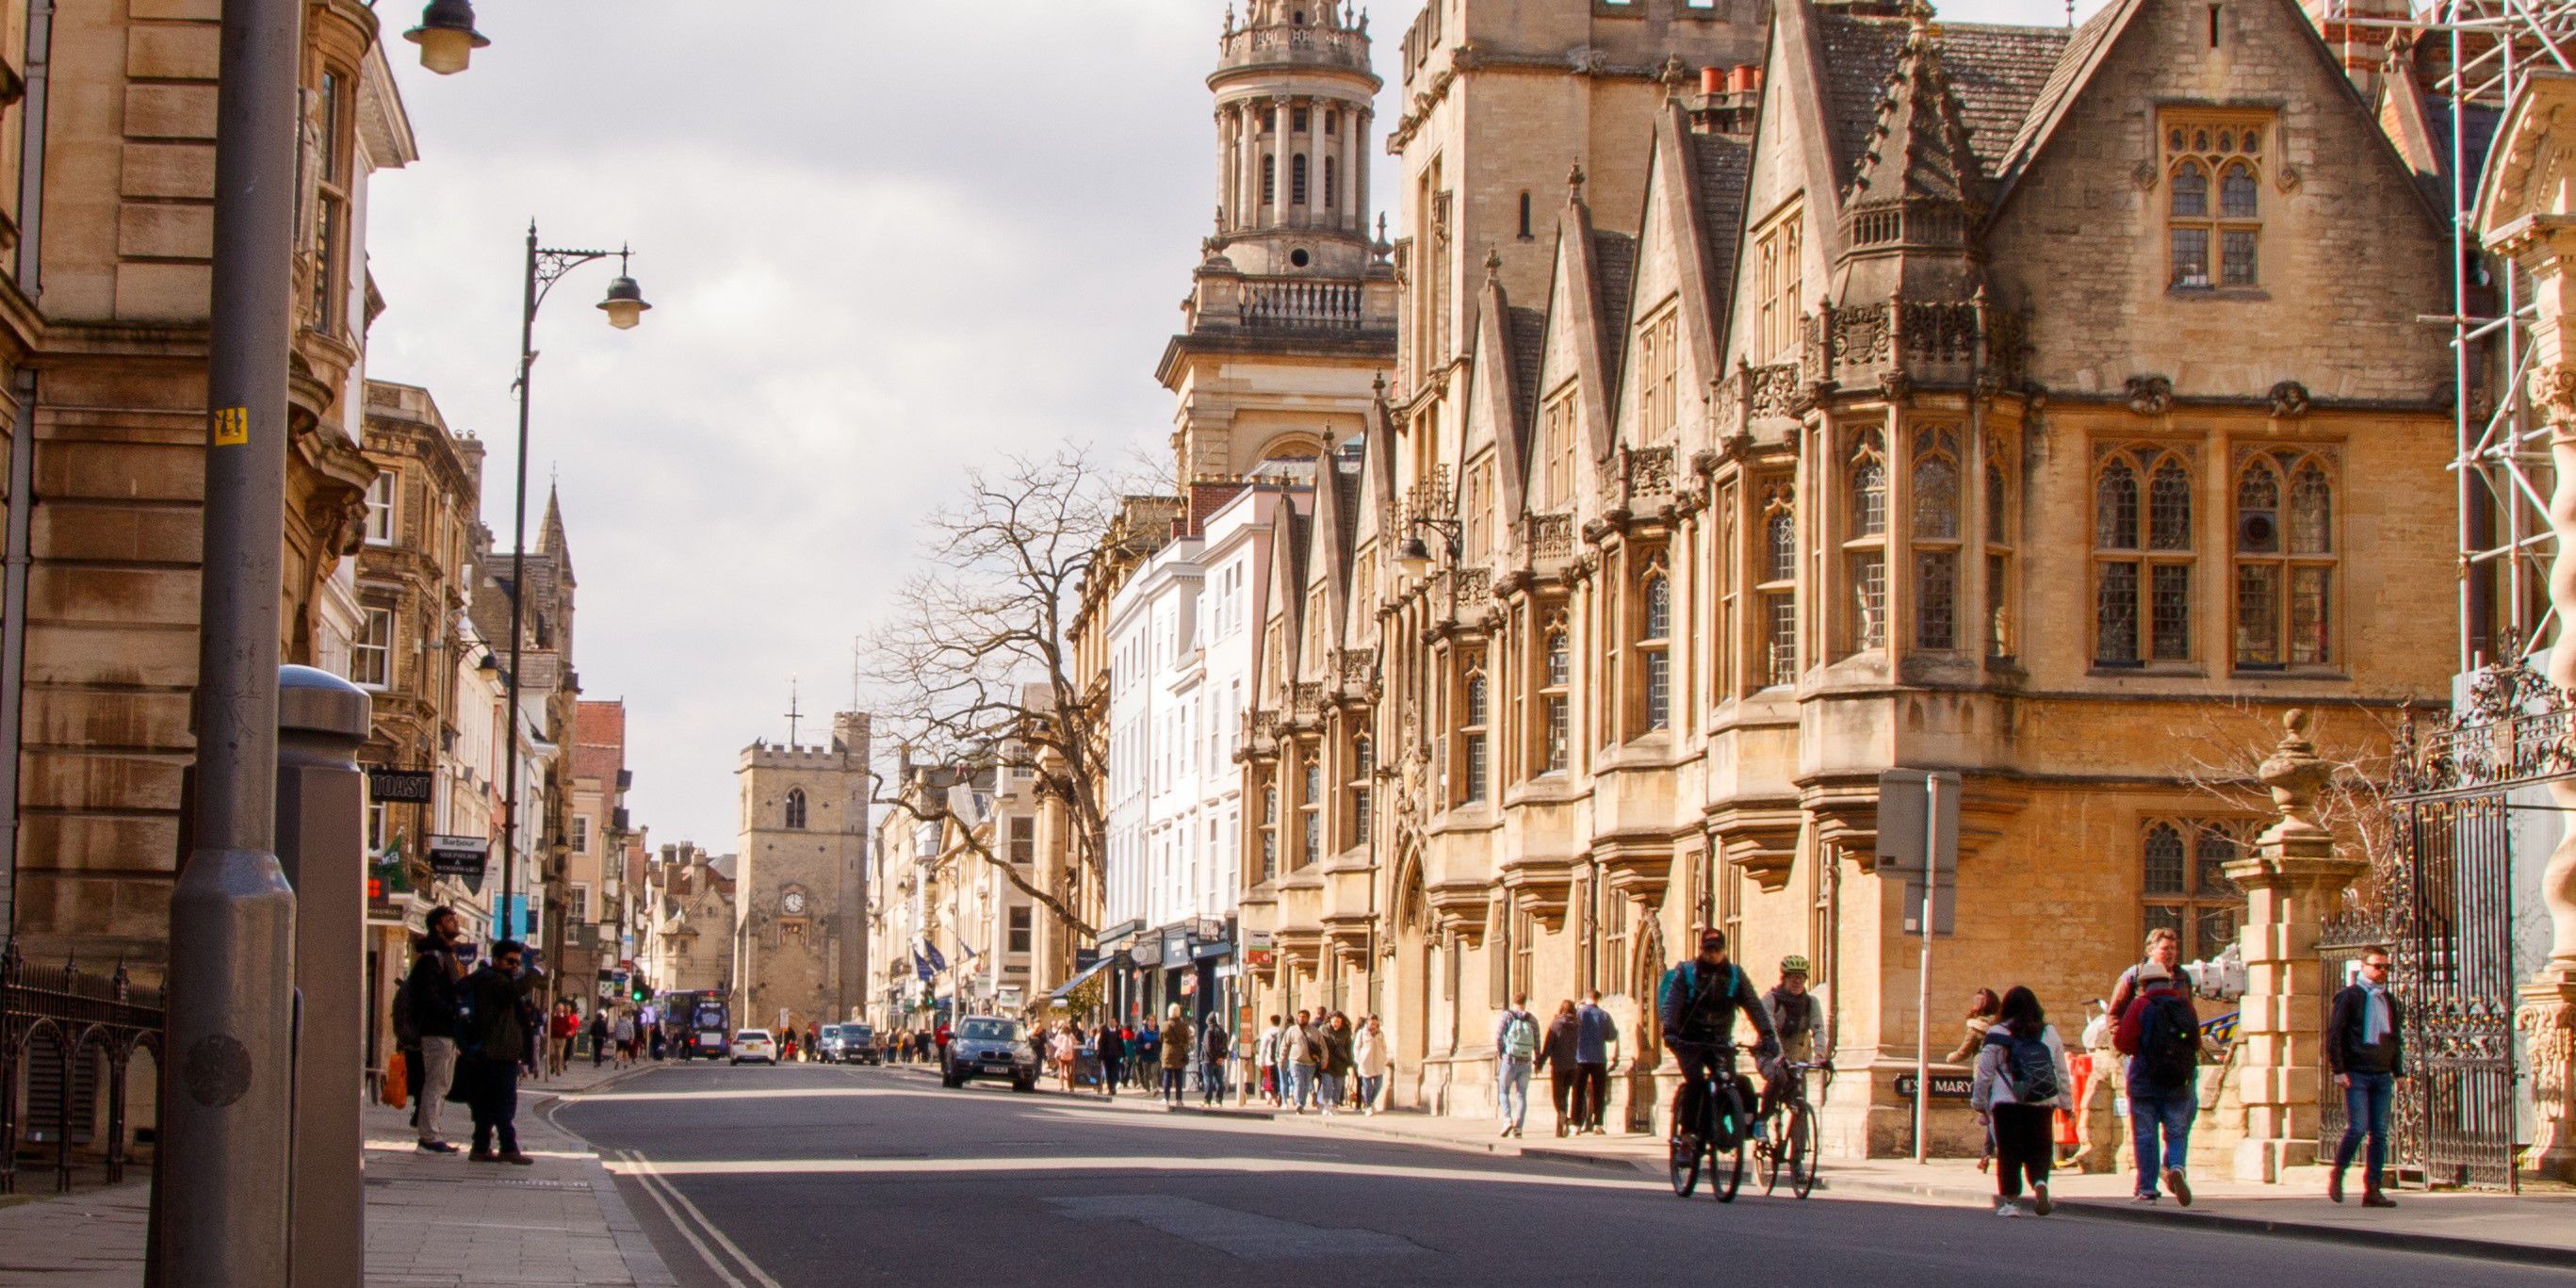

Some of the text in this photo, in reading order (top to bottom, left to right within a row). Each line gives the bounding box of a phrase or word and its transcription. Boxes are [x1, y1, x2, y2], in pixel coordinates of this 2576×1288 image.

[372, 774, 430, 798] TOAST
[442, 838, 475, 846] Barbour
[1935, 1080, 1974, 1093] MARY
